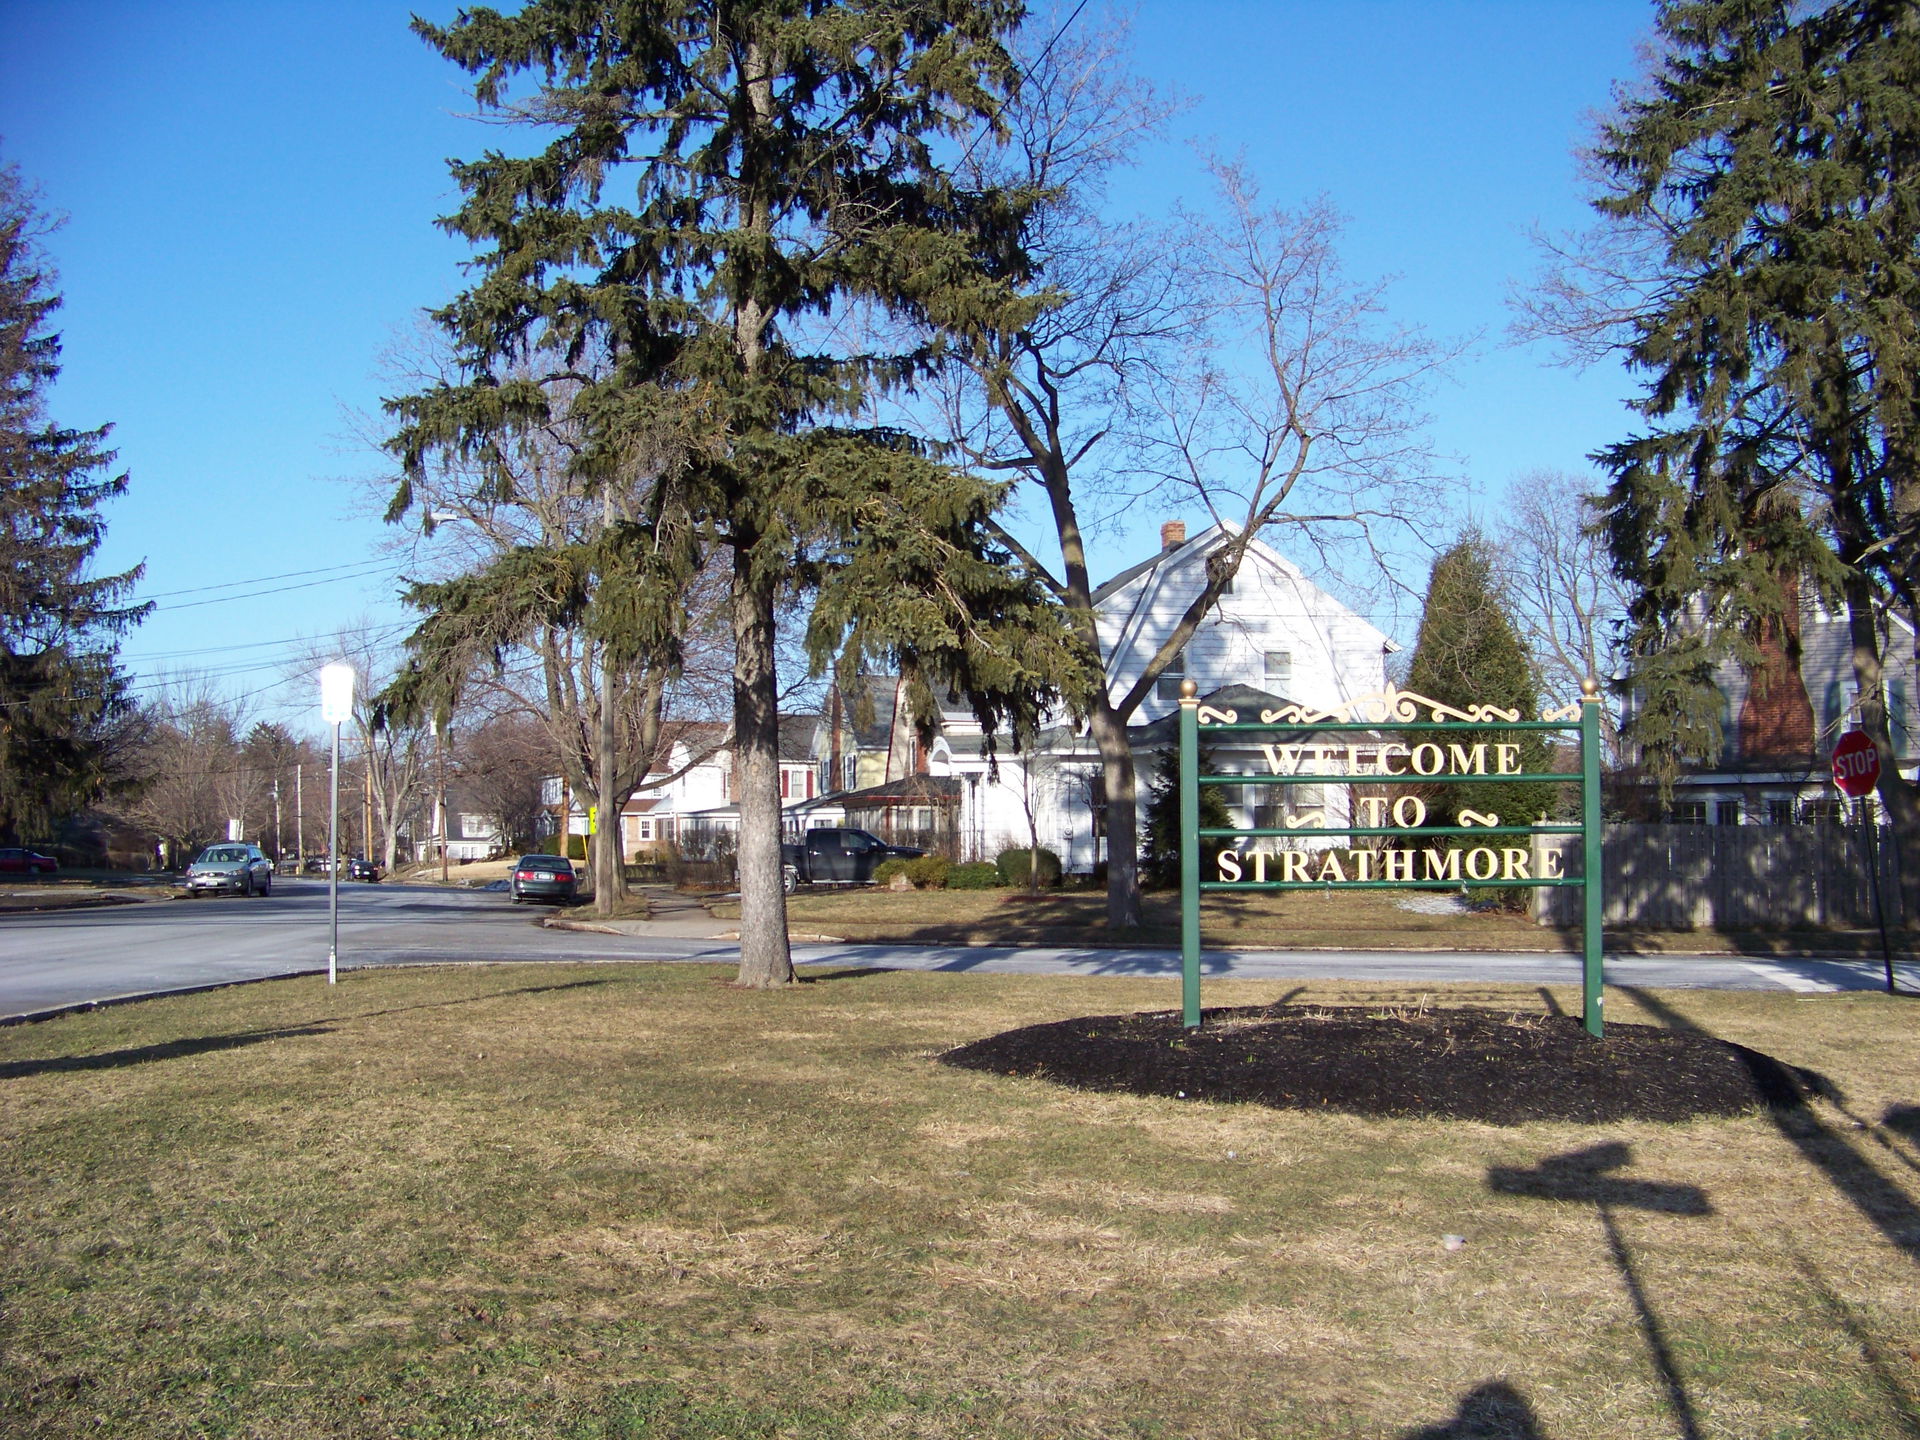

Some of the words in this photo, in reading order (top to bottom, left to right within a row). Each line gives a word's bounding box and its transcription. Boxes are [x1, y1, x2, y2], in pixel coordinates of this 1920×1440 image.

[1262, 743, 1522, 776] WELCOME
[1836, 748, 1876, 780] STOP
[1360, 796, 1426, 828] TO
[1217, 847, 1565, 882] STRATHMORE
